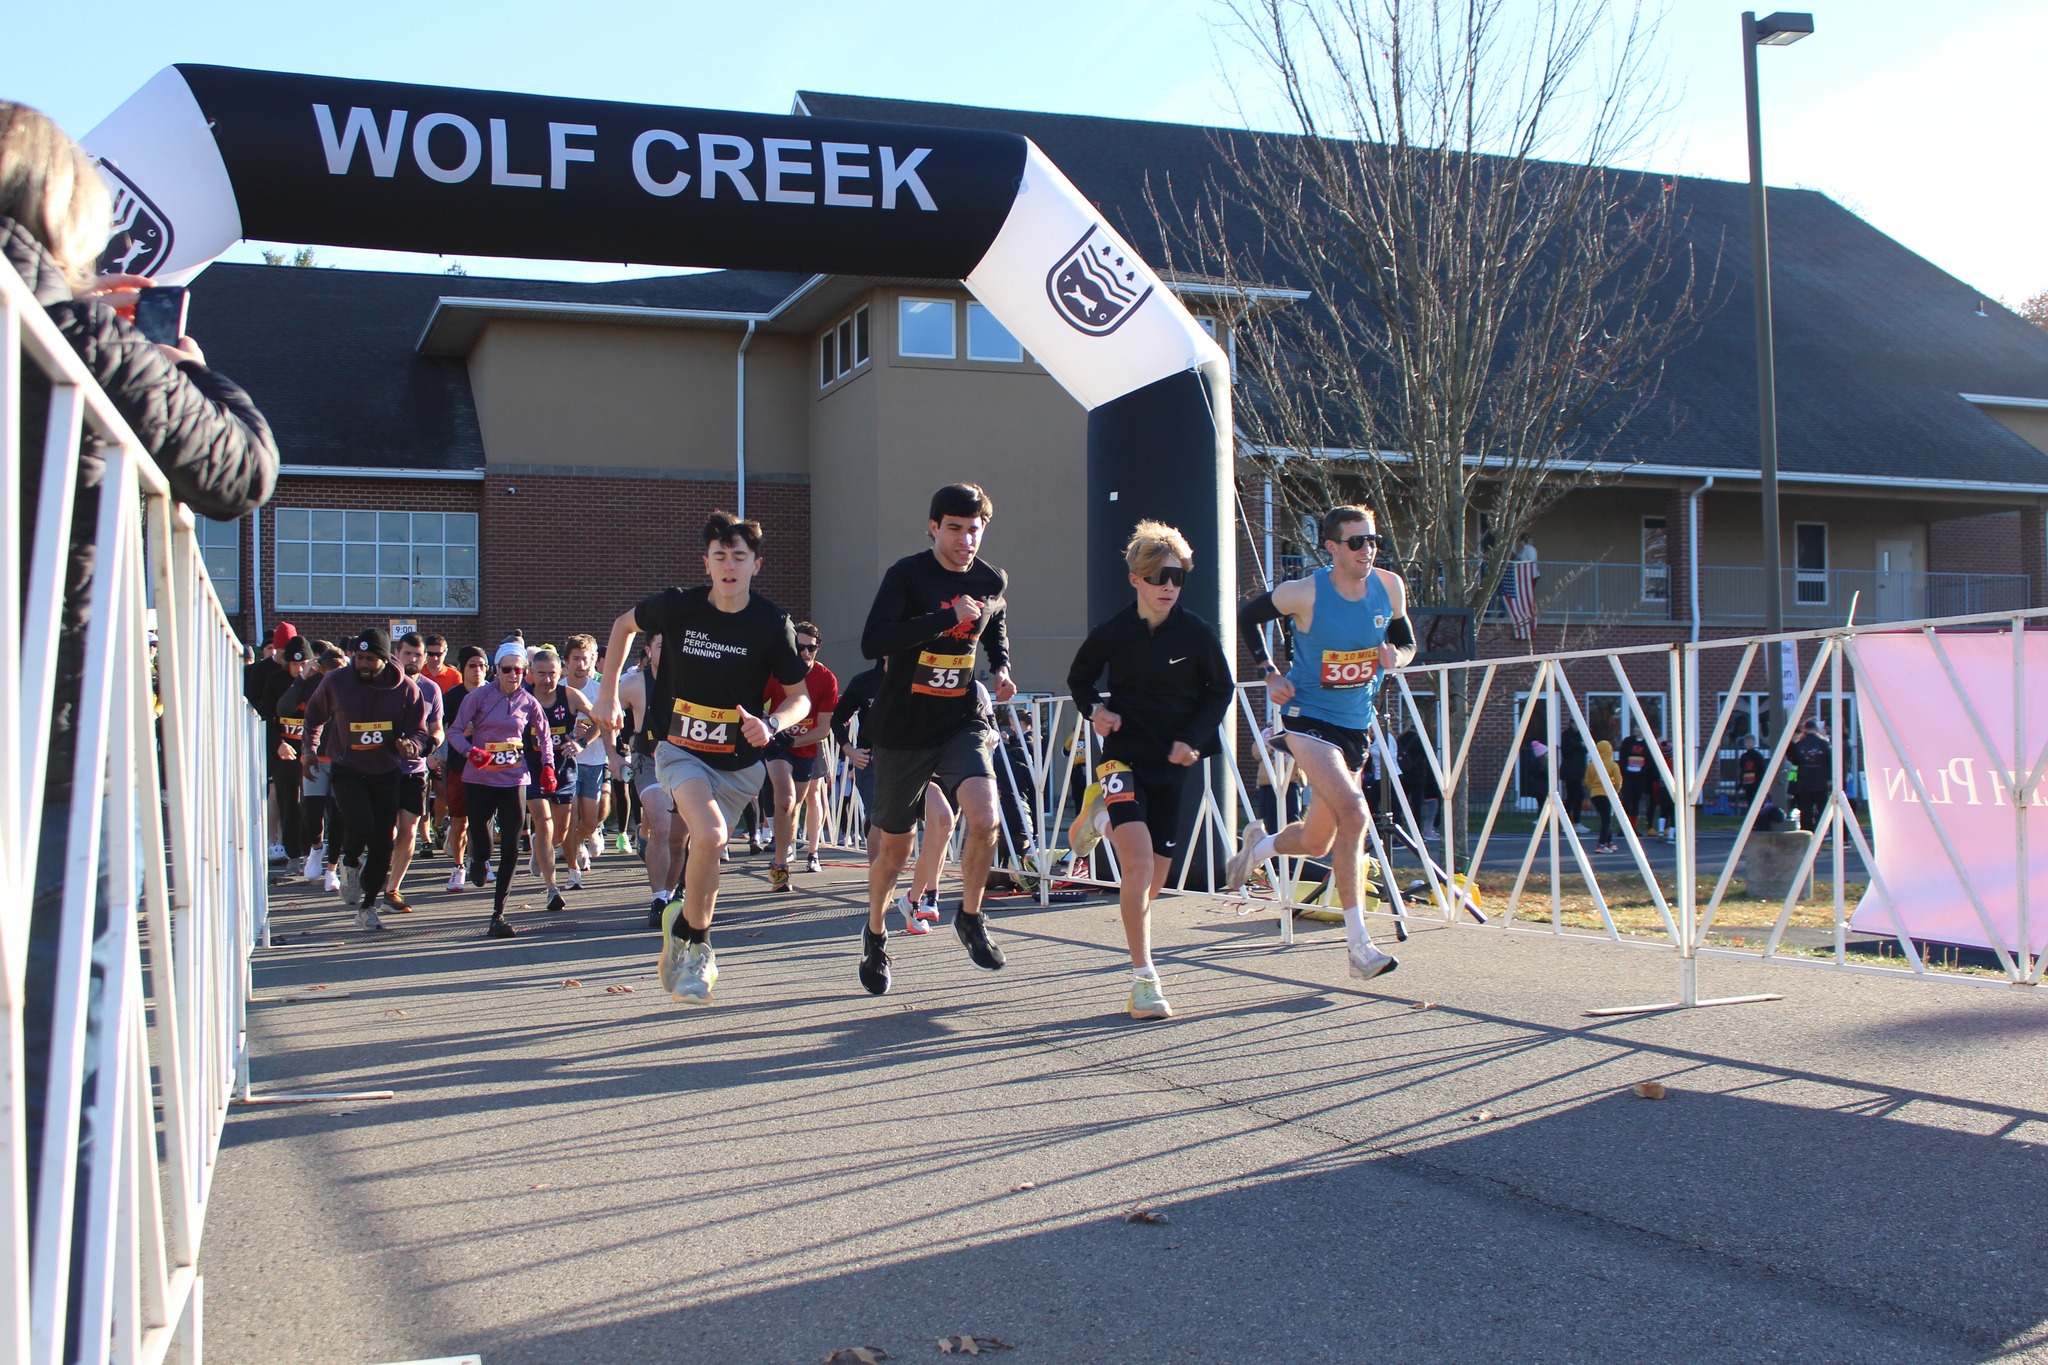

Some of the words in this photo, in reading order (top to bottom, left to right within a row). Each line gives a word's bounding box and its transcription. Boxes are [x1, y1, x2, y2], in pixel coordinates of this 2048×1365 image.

[313, 103, 599, 190] WOLF
[631, 128, 939, 212] CREEK
[395, 625, 413, 634] 9:00
[685, 629, 711, 641] PEAK.
[682, 645, 722, 659] RUNNING
[683, 637, 748, 656] PERFORMANCE
[1344, 653, 1356, 661] 10
[1357, 648, 1378, 660] MILE
[952, 657, 963, 666] 5K
[1326, 661, 1373, 681] 305
[928, 668, 960, 689] 35
[710, 709, 726, 720] 5K
[284, 724, 305, 736] 172
[680, 715, 728, 744] 184
[360, 730, 384, 745] 68
[536, 734, 562, 746] 18
[492, 750, 518, 765] 85
[1105, 761, 1117, 772] 5K
